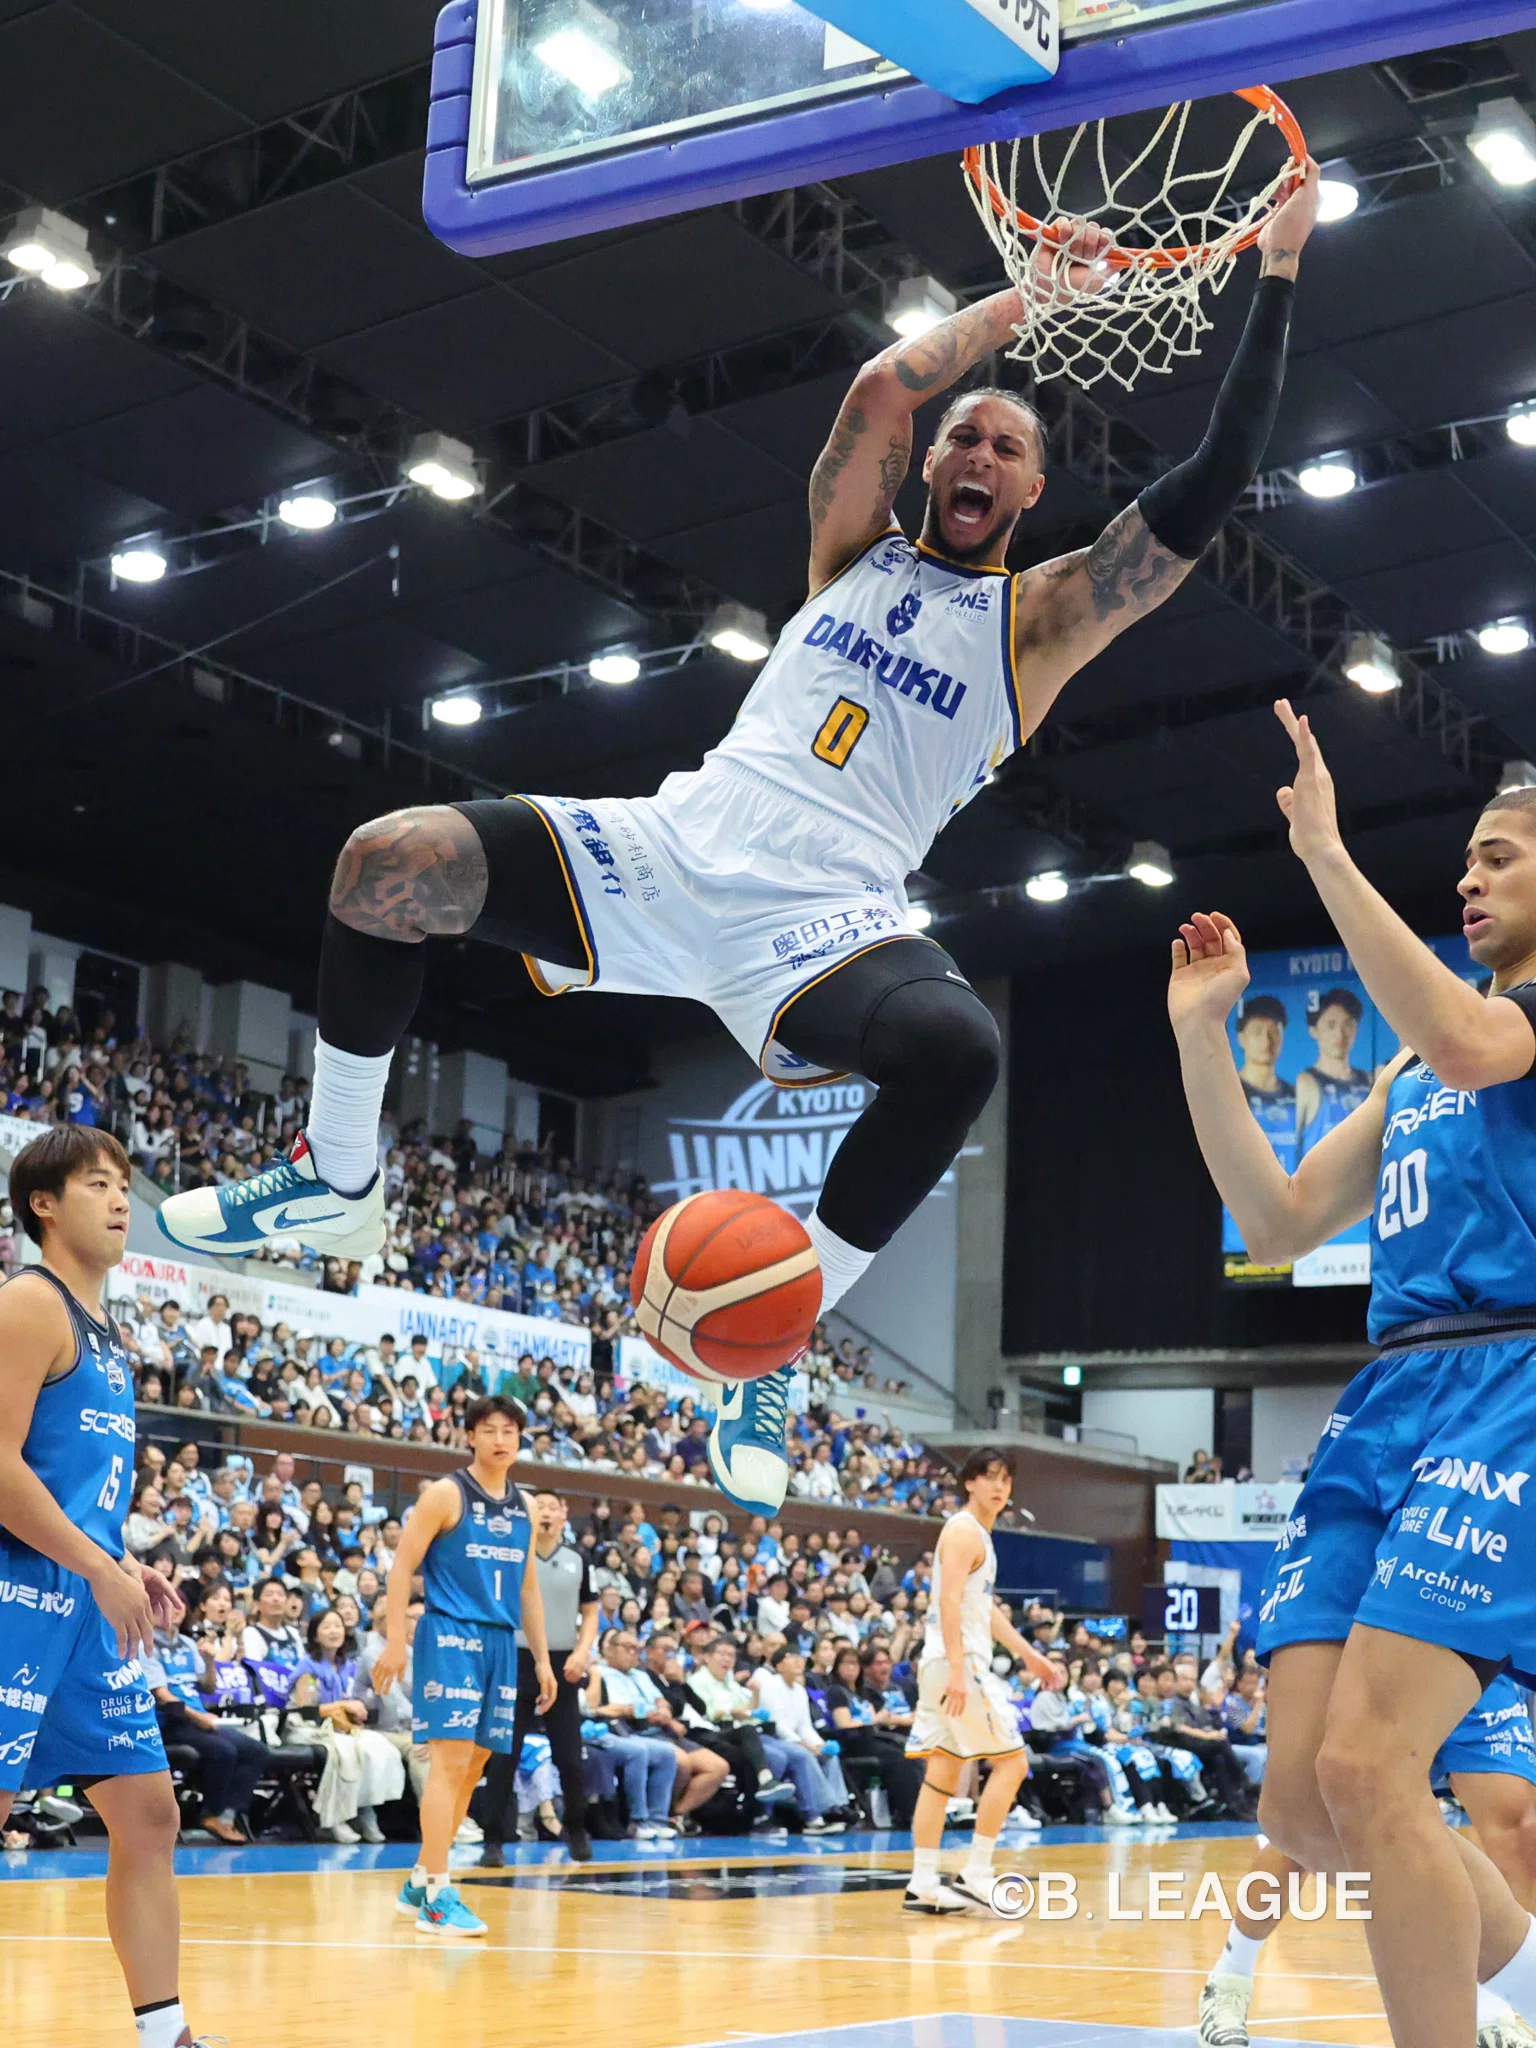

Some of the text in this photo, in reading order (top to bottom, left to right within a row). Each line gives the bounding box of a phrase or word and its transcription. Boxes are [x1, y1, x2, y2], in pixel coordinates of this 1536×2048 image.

[811, 694, 870, 771] 0
[1289, 952, 1342, 976] KYOTO
[1307, 990, 1320, 1013] 3
[778, 1084, 866, 1115] KYOTO
[1378, 1148, 1429, 1241] 20
[96, 1454, 124, 1511] 15
[1426, 1506, 1508, 1562] Live
[494, 1570, 502, 1600] 1
[1400, 1562, 1493, 1604] Archi M's
[1419, 1586, 1467, 1612] Group
[101, 1695, 131, 1708] DRUG
[102, 1705, 132, 1719] STORE
